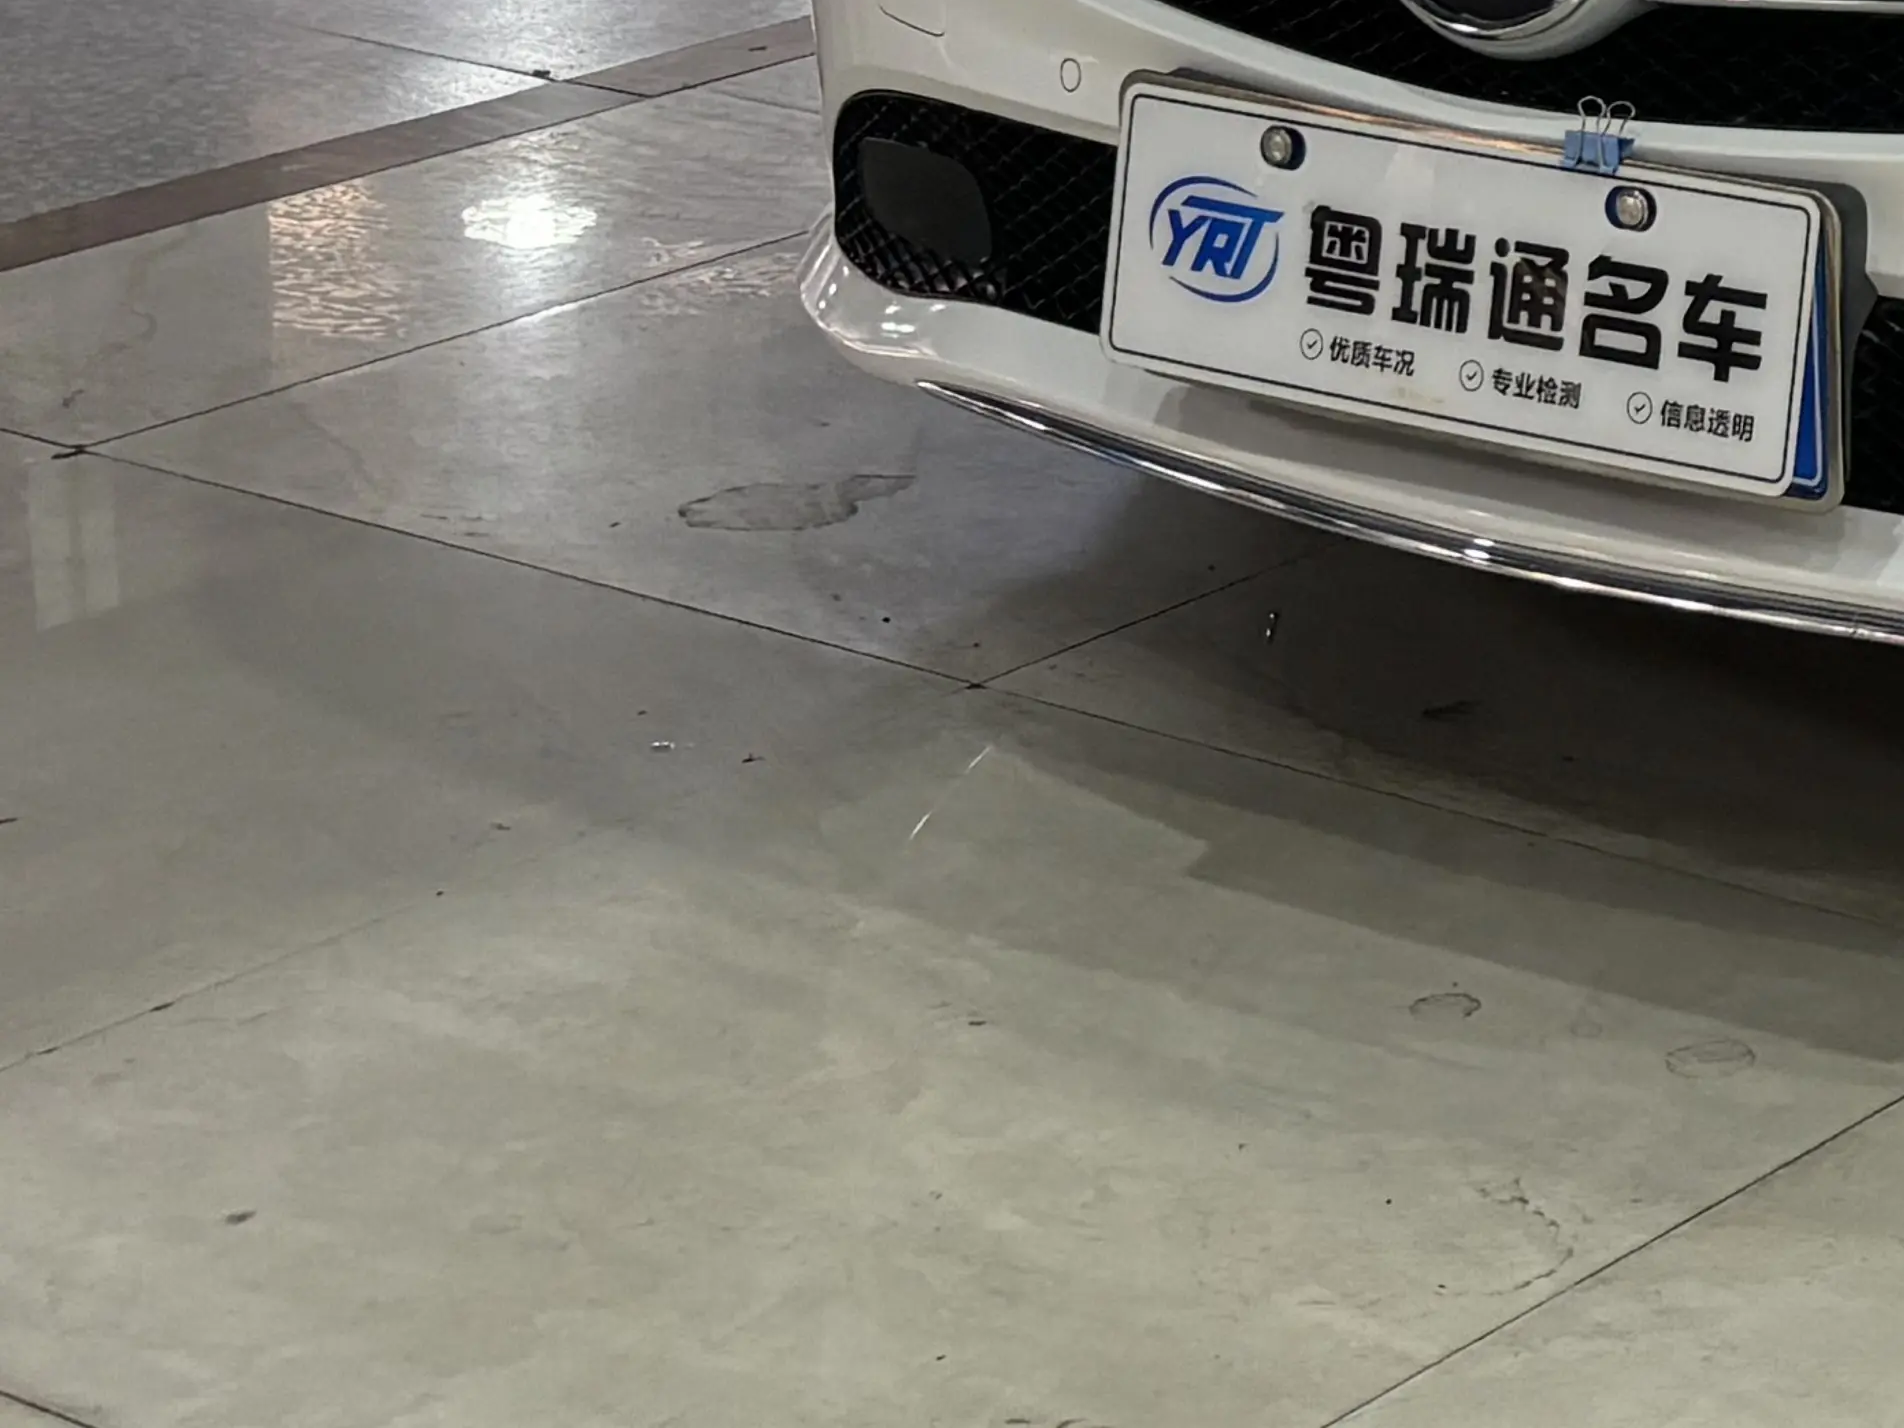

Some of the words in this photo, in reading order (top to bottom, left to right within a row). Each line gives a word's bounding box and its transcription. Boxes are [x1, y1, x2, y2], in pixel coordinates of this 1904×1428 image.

[1160, 195, 1286, 282] YRT
[1303, 202, 1770, 385] 粤瑞通名车
[1328, 334, 1417, 379] 优质车况
[1490, 365, 1583, 410] 专业检测
[1658, 397, 1756, 446] 信息透明
